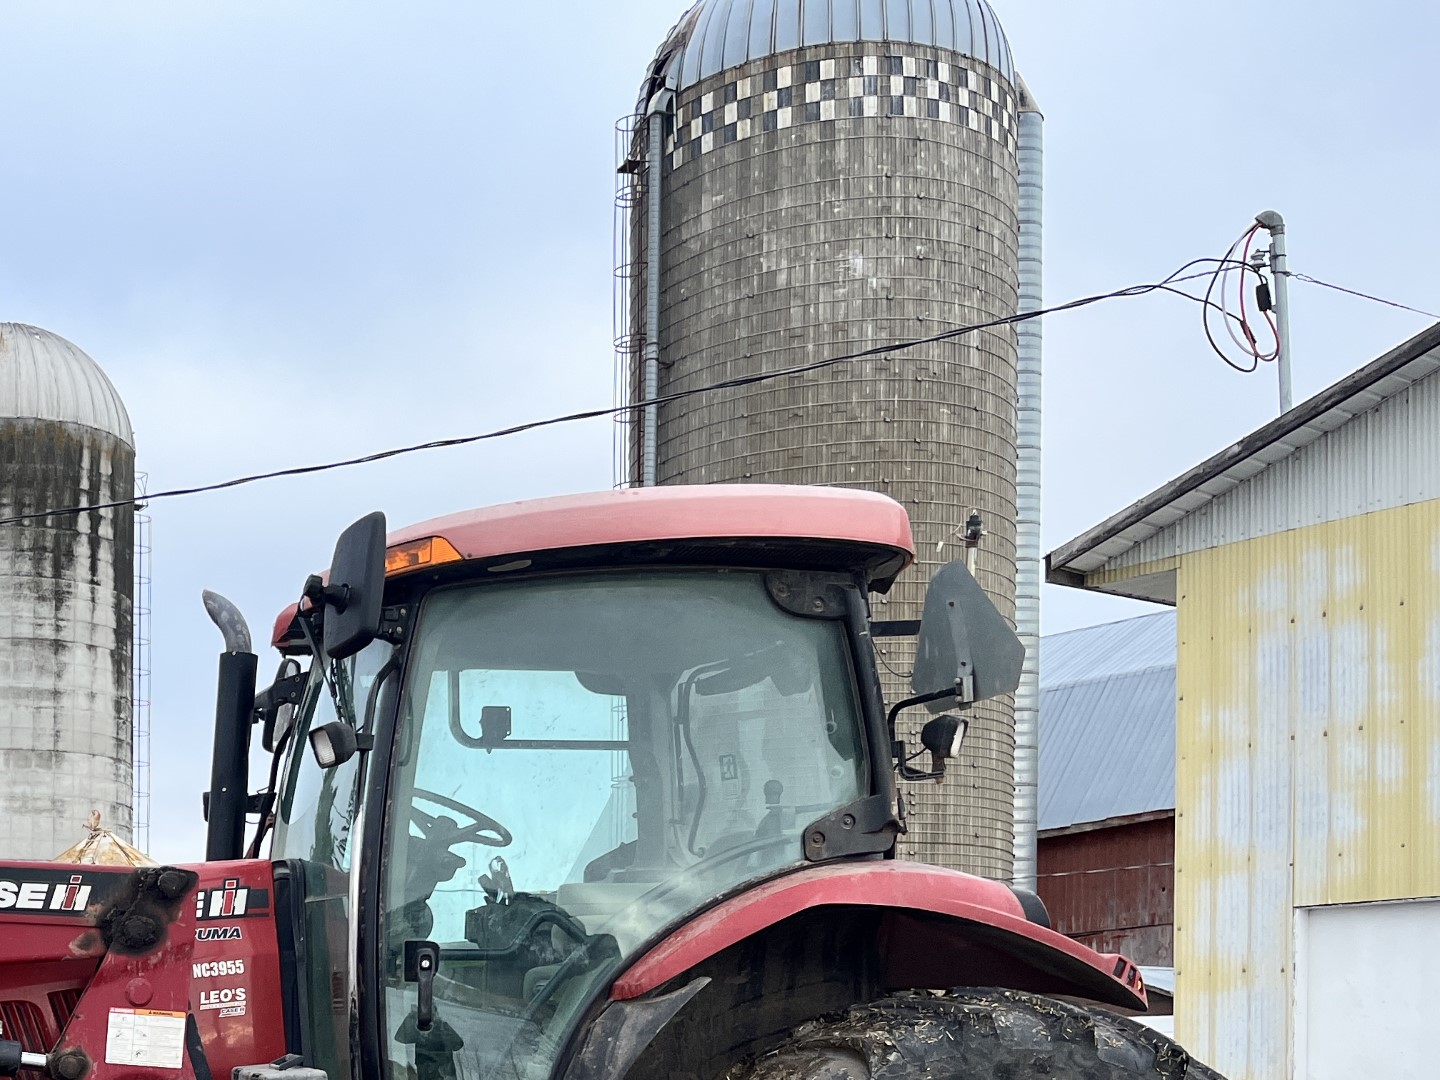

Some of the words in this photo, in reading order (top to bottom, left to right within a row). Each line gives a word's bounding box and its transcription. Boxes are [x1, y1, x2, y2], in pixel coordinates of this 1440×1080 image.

[195, 926, 242, 941] UMA
[192, 959, 245, 979] NC3955
[200, 987, 246, 1004] LEO'S
